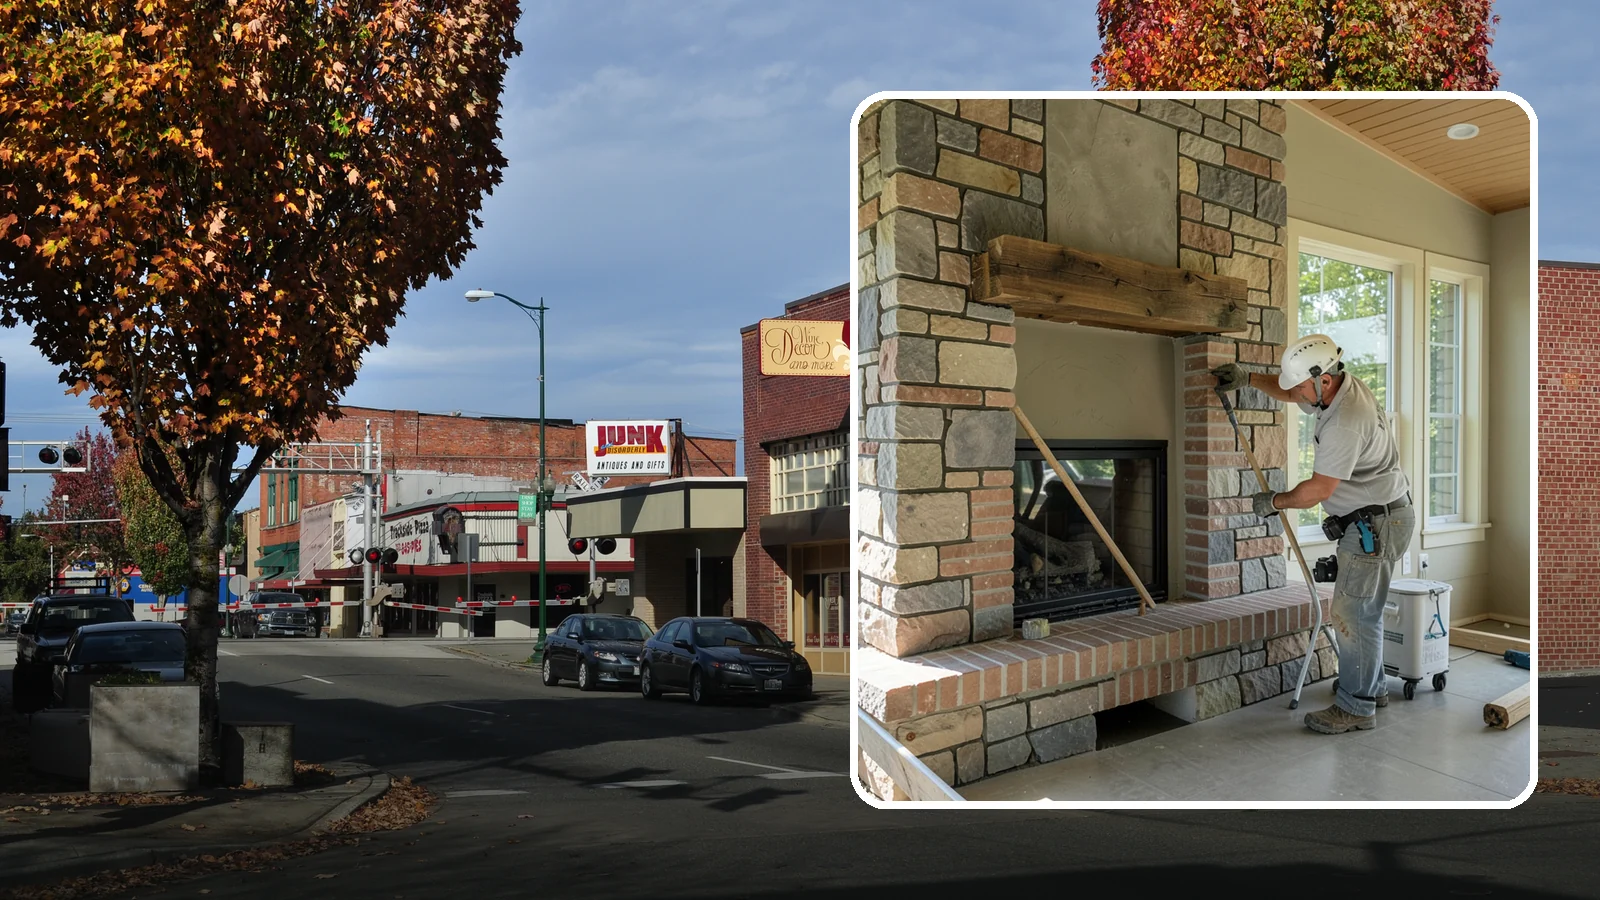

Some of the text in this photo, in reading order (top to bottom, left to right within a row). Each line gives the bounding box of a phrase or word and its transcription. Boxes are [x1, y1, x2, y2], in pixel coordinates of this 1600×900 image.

[595, 425, 665, 457] JUNK
[607, 446, 646, 454] DISORDERLY
[597, 460, 665, 470] ANTIQUES AND GIFTS
[390, 519, 429, 540] Trackside Pizza
